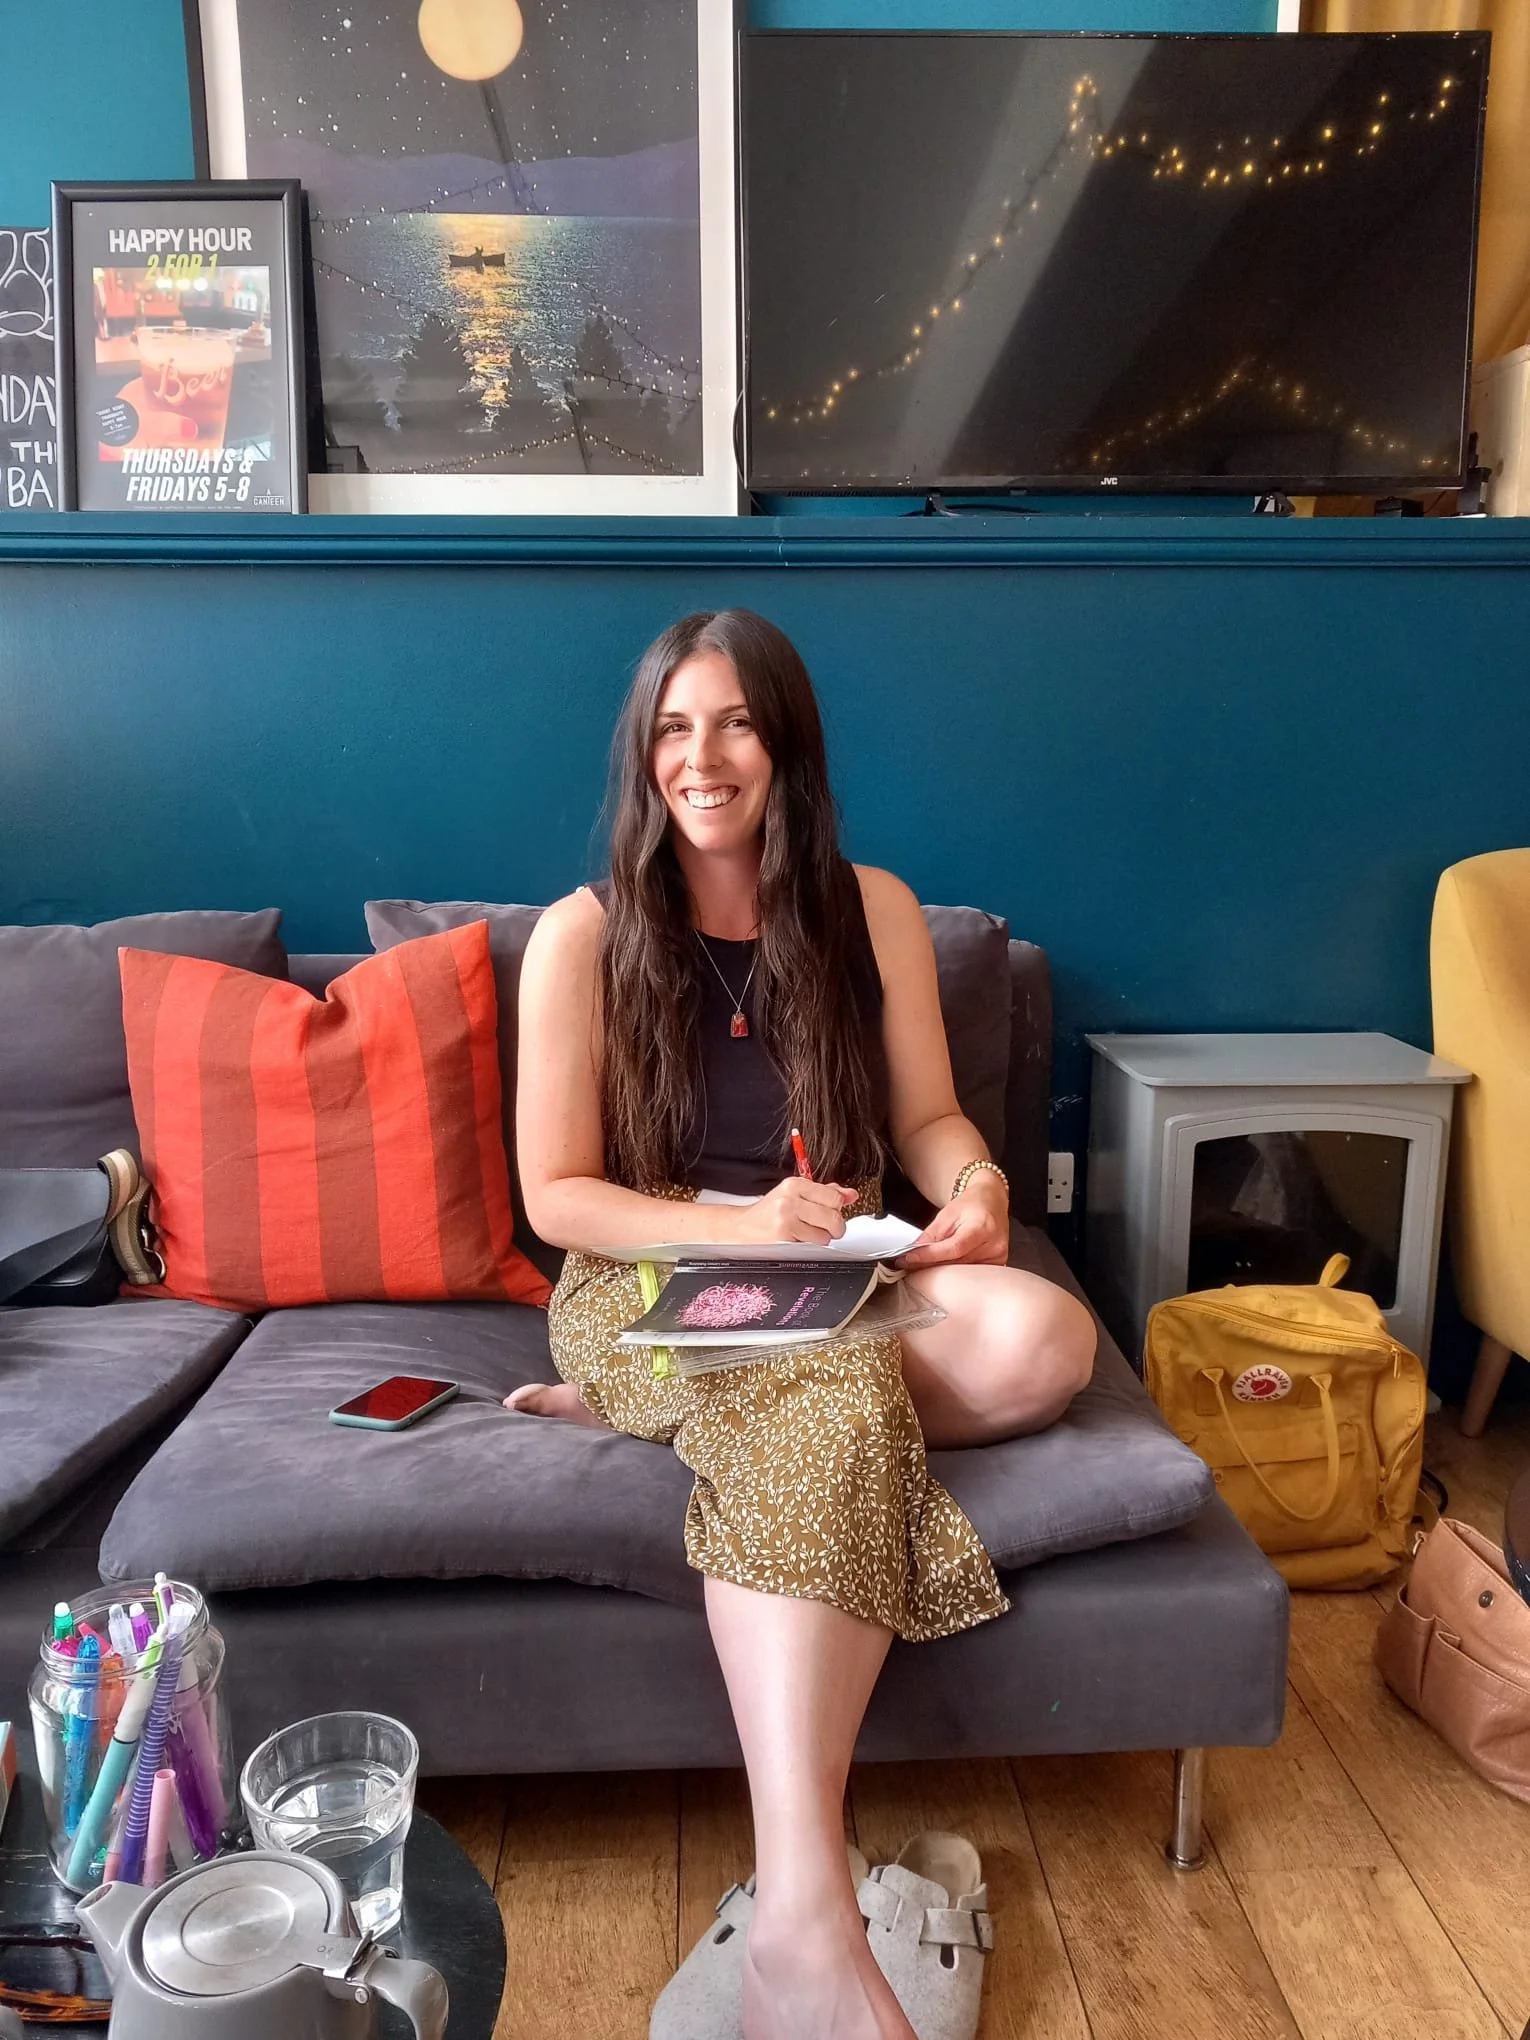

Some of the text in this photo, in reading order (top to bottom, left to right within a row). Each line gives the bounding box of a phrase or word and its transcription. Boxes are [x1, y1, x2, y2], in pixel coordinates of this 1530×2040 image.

[109, 227, 252, 253] HAPPY HOUR
[145, 254, 160, 281] 2
[163, 254, 204, 280] FOR
[153, 357, 227, 403] Beer
[121, 447, 255, 474] THURSDAYS &
[126, 476, 251, 502] FRIDAYS 5-8
[1101, 477, 1118, 486] JVC
